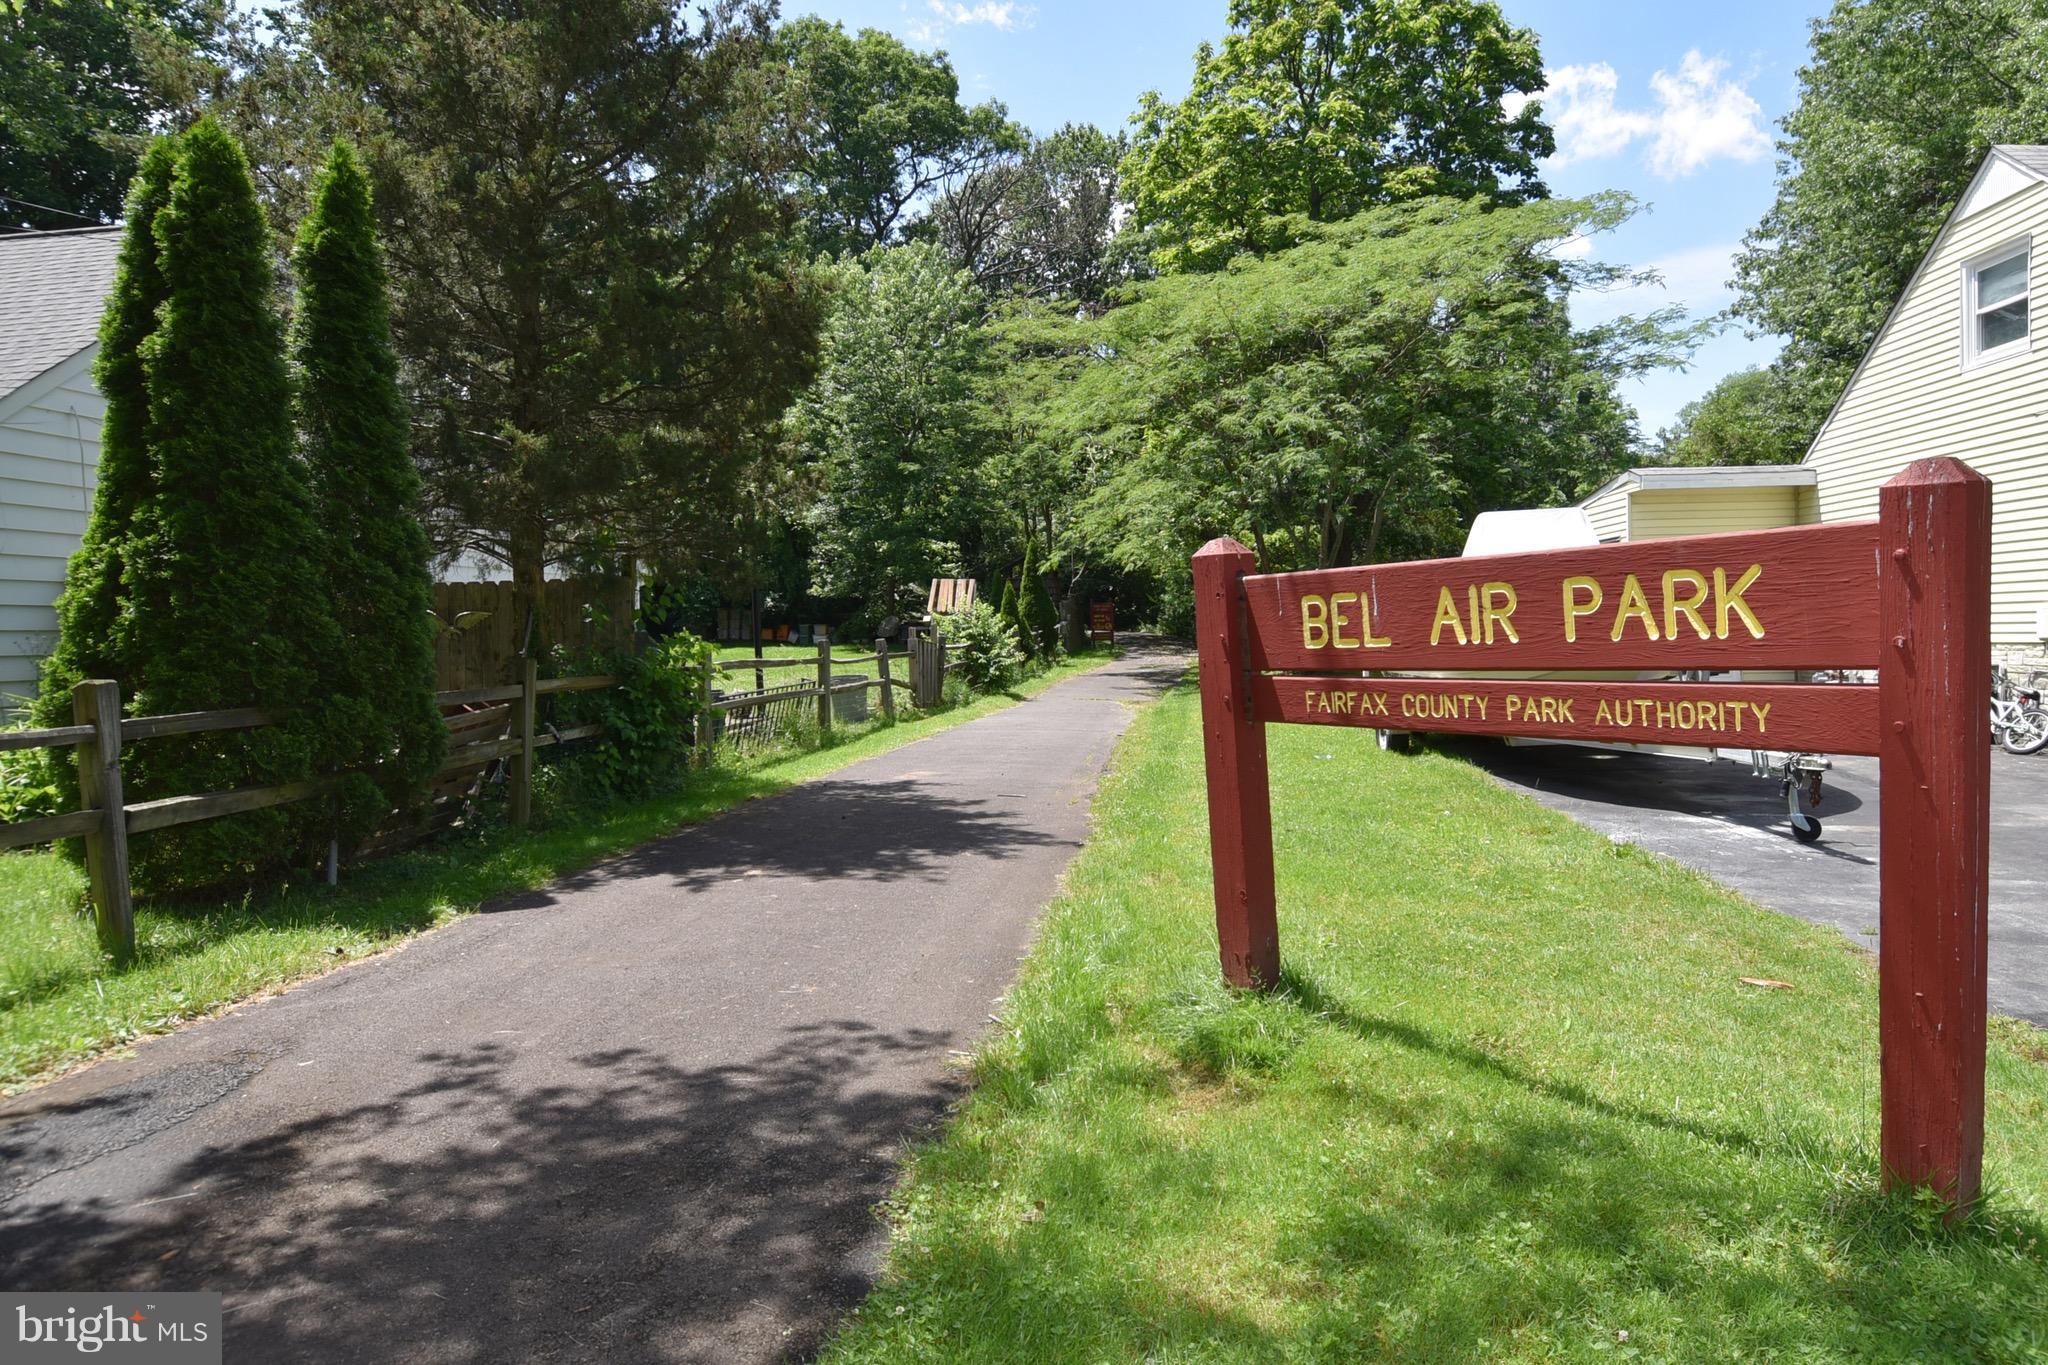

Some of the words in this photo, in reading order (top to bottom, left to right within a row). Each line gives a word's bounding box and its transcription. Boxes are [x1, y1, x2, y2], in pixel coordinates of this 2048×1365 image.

[1301, 592, 1392, 649] BEL
[1430, 582, 1519, 646] AIR
[1562, 563, 1766, 642] PARK
[1304, 689, 1389, 716] FAIRFAX
[1401, 693, 1489, 720] COUNTY
[1505, 695, 1575, 723] PARK
[1594, 698, 1773, 734] AUTHORITY
